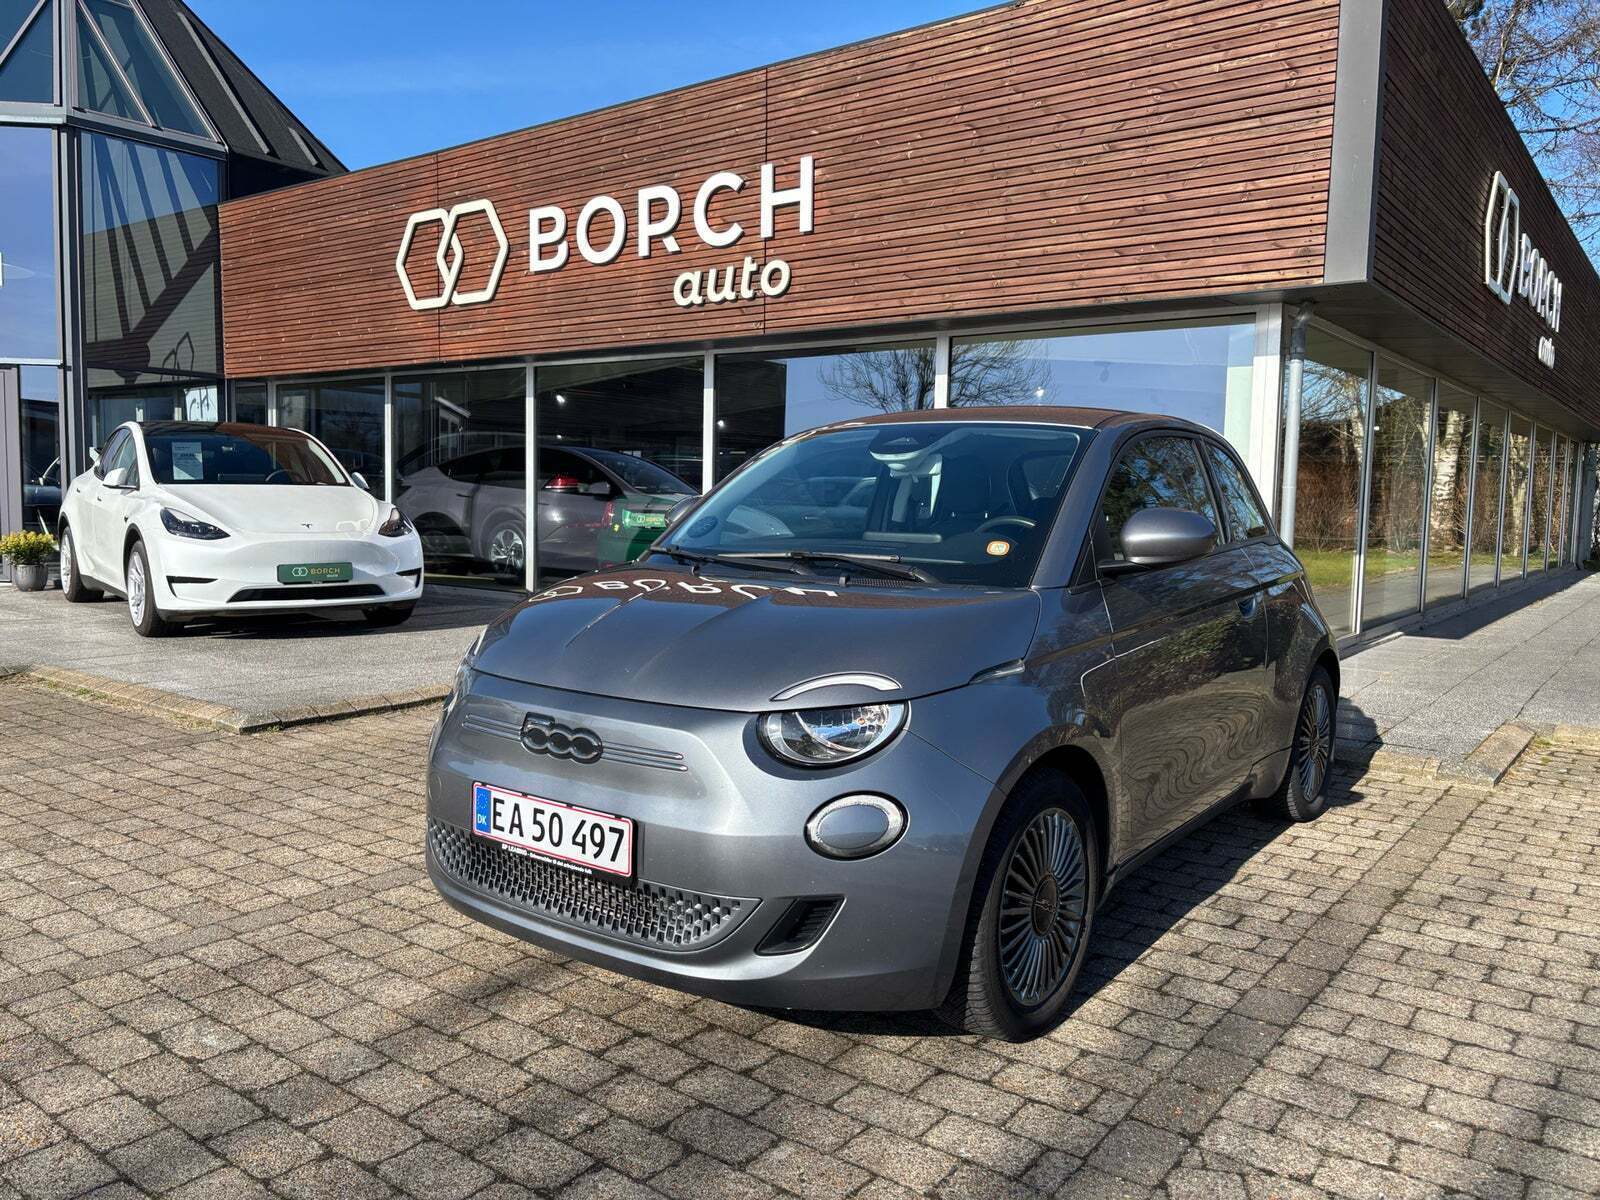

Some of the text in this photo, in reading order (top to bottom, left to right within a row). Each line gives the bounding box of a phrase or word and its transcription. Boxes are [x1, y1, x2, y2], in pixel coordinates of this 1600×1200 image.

[528, 154, 816, 274] BORCH
[672, 255, 792, 308] auto
[1518, 232, 1563, 333] BORCH
[310, 567, 340, 575] BORCH
[519, 711, 603, 765] 500
[477, 813, 488, 827] DK
[492, 797, 525, 839] EA
[531, 808, 564, 848] 50
[571, 819, 625, 863] 497
